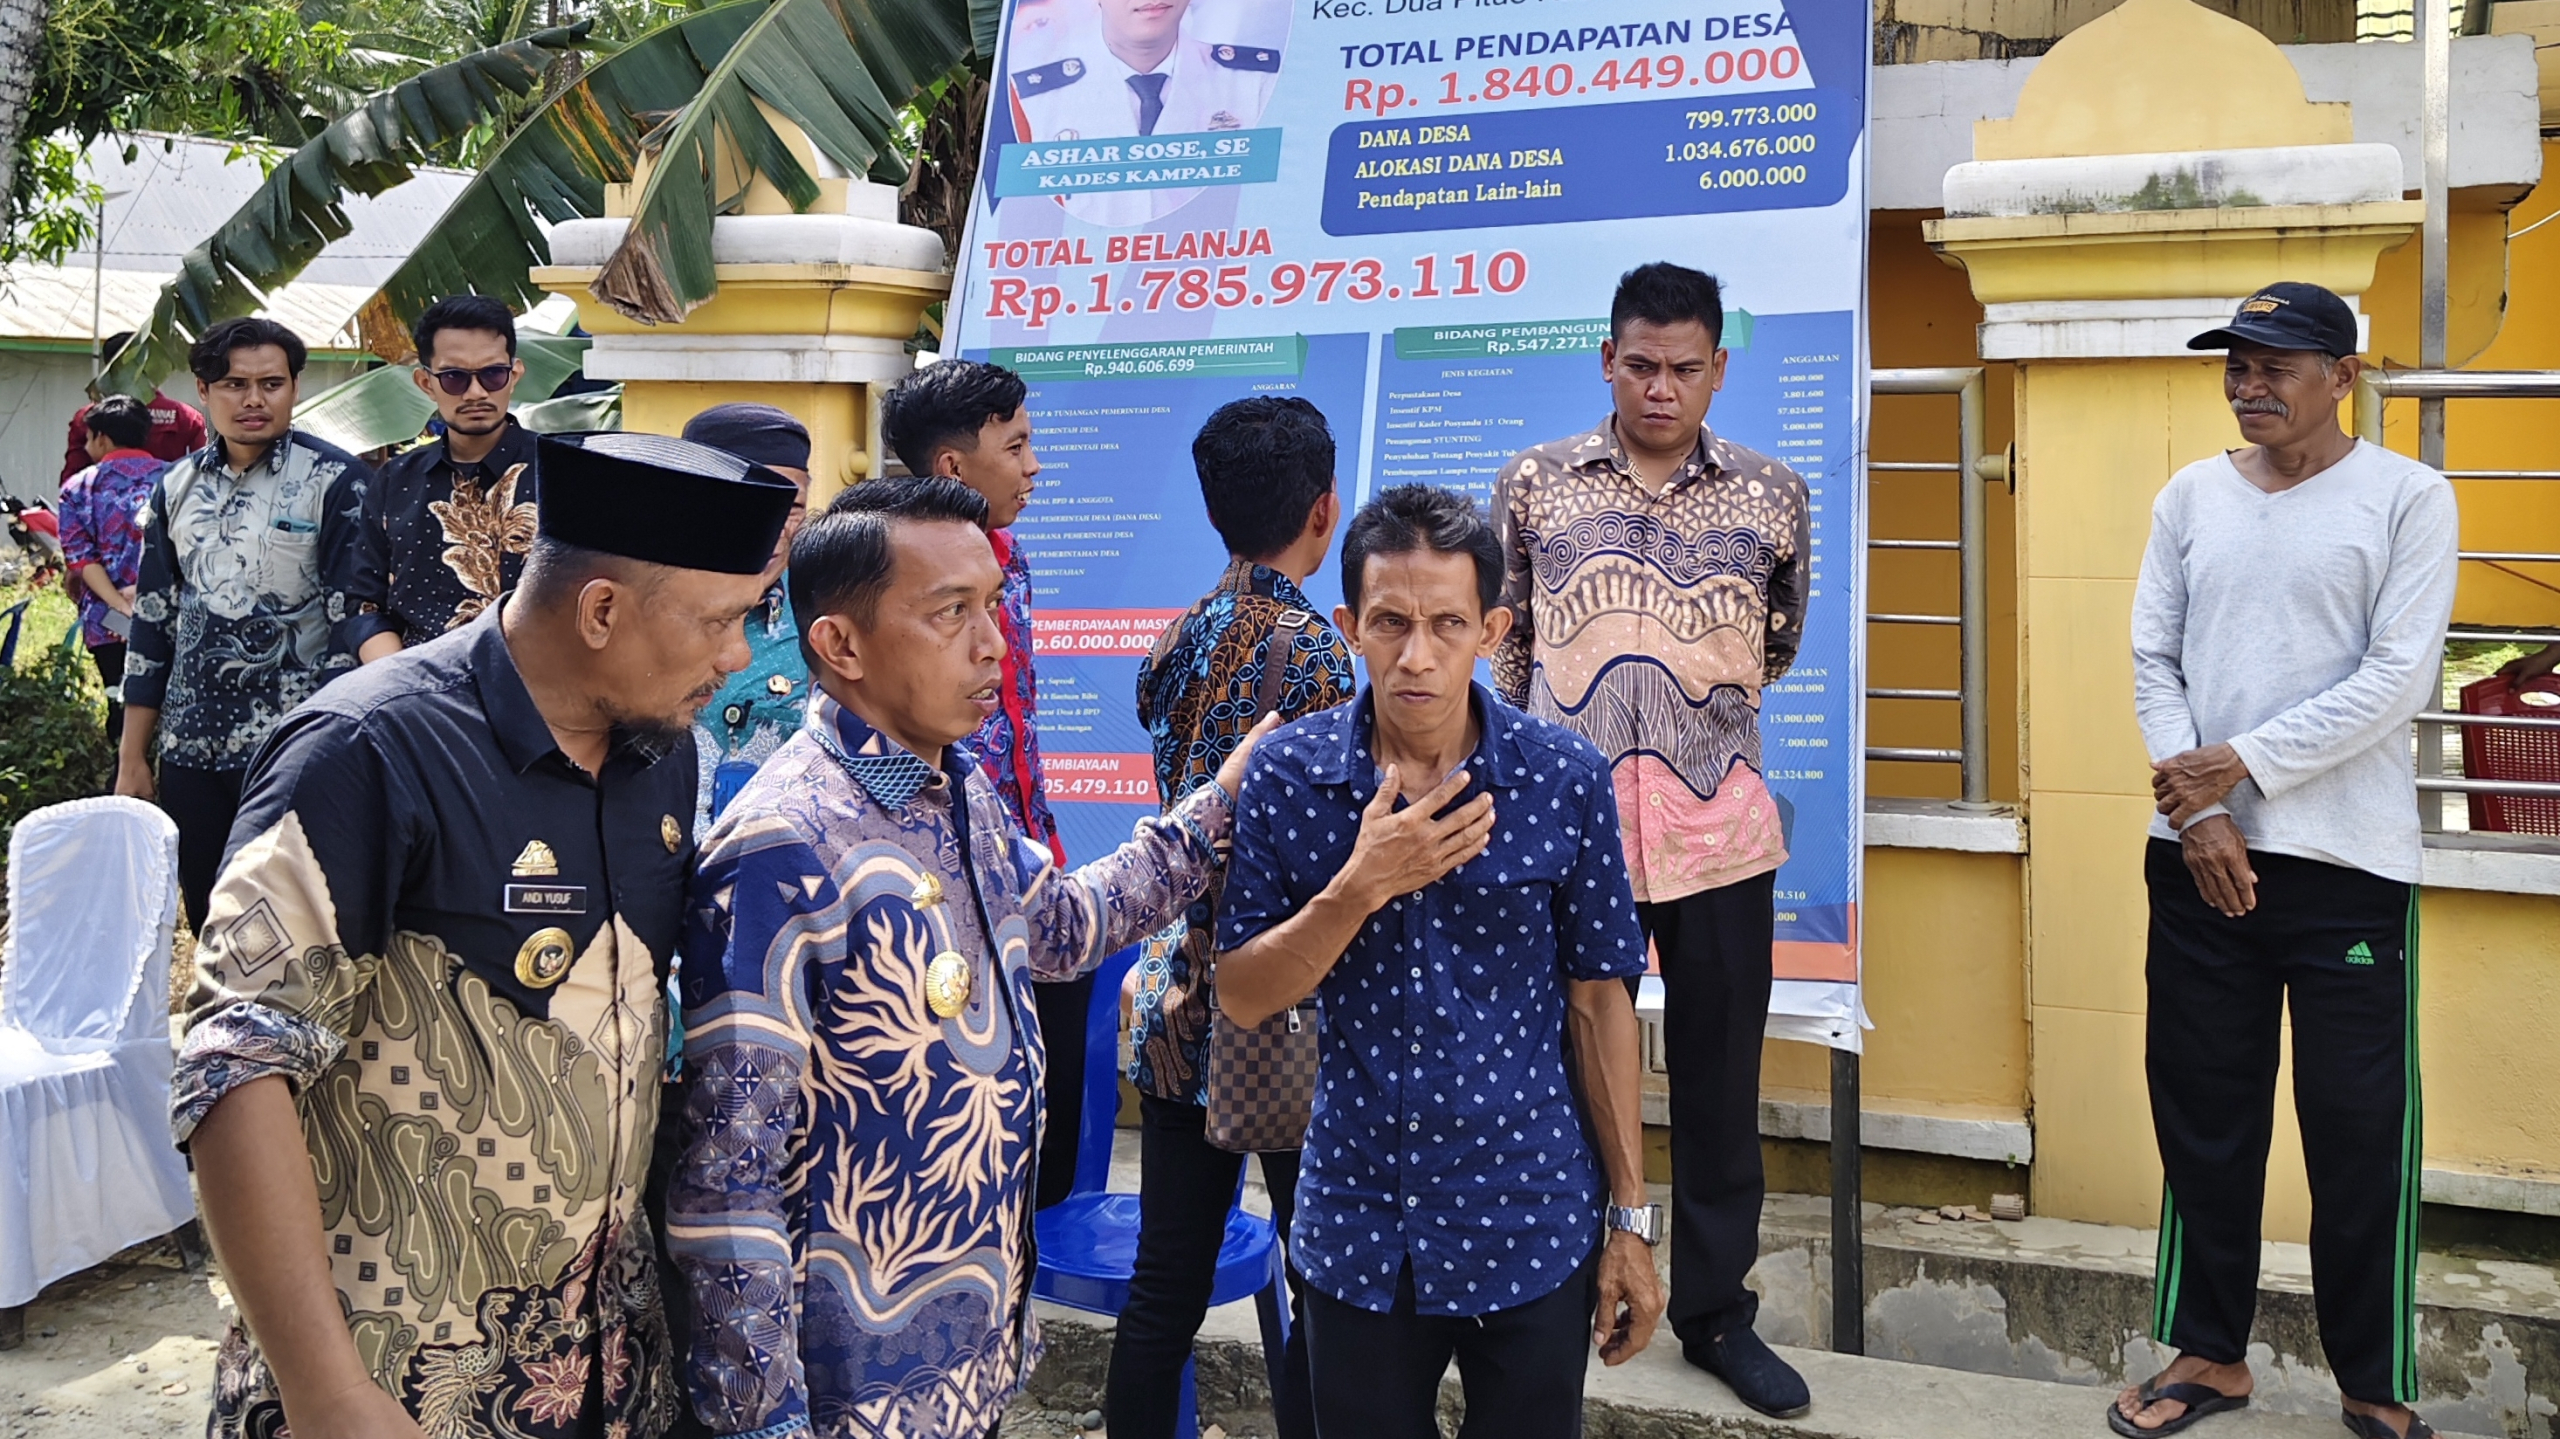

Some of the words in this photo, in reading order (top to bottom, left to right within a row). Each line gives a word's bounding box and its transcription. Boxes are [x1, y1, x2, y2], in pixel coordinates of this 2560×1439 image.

[1312, 0, 1373, 20] Kec.
[1339, 39, 1444, 69] TOTAL
[1454, 19, 1692, 61] PENDAPATAN
[1704, 11, 1797, 41] DESA
[1343, 77, 1419, 117] Rp.
[1437, 44, 1802, 105] 1.840.449.000
[1685, 103, 1817, 131] 799.773.000
[1357, 128, 1412, 150] DANA
[1417, 124, 1471, 144] DESA
[1021, 144, 1120, 168] ASHAR
[1127, 139, 1207, 161] SOSE,
[1214, 136, 1251, 157] SE
[1664, 134, 1816, 164] 1.034.676.000
[1354, 156, 1442, 179] ALOKASI
[1447, 152, 1503, 174] DANA
[1509, 147, 1564, 169] DESA
[1038, 170, 1120, 189] KADES
[1126, 163, 1243, 185] KAMPALE
[1698, 165, 1808, 190] 6.000.000
[1357, 187, 1469, 211] Pendapatan
[1475, 179, 1563, 203] Lain-lain
[983, 239, 1094, 269] TOTAL
[1105, 228, 1273, 264] BELANJA
[983, 250, 1528, 329] Rp.1.785.973.110
[1433, 327, 1497, 341] BIDANG
[1501, 322, 1612, 339] PEMBANGUN
[1486, 336, 1610, 355] Rp.547.271.1
[1014, 350, 1065, 364] BIDANG
[1067, 345, 1193, 362] PENYELENGGARAN
[1195, 341, 1275, 357] PEMERINTAH
[1782, 353, 1840, 364] ANGGARAN
[1084, 358, 1196, 378] Rp.940.606.699
[1440, 370, 1465, 379] JENIS
[1467, 367, 1514, 377] KEGIATAN
[1778, 373, 1825, 384] 10.000.000
[1251, 382, 1297, 392] ANGGARAN
[1388, 390, 1441, 401] Perpustakaan
[1442, 389, 1462, 398] Desa
[1026, 410, 1046, 418] ETAP
[1054, 408, 1100, 418] TUNJANGAN
[1100, 407, 1150, 416] PEMERINTAH
[1151, 406, 1171, 414] DESA
[1421, 405, 1443, 414] KPM
[1443, 418, 1482, 430] Posyandu
[1484, 418, 1494, 426] 15
[1497, 417, 1525, 427] Orang
[1079, 426, 1099, 434] DESA
[1433, 435, 1482, 444] STUNTING
[1776, 438, 1823, 448] 10.000.000
[1050, 443, 1099, 452] PEMERINTAH
[1100, 442, 1120, 451] DESA
[1431, 451, 1463, 462] Tentang
[1465, 449, 1500, 460] Penyakit
[1501, 448, 1518, 458] Tub
[1039, 462, 1069, 470] NGGOTA
[1439, 466, 1468, 477] Lampu
[1076, 496, 1114, 505] ANGGOTA
[1040, 514, 1090, 523] PEMERINTAH
[1091, 513, 1111, 522] DESA
[1063, 531, 1113, 540] PEMERINTAH
[1114, 530, 1134, 539] DESA
[1038, 550, 1099, 559] PEMERINTAHAN
[1100, 549, 1120, 558] DESA
[1030, 568, 1086, 577] EMERINTAHAN
[1032, 587, 1060, 595] NAHAN
[1030, 619, 1131, 632] PEMBERDAYAAN
[1133, 618, 1172, 631] MASY
[1032, 634, 1155, 653] p.60.000.000
[1784, 667, 1828, 677] GGARAN
[1769, 683, 1825, 694] 10.000.000
[1769, 713, 1826, 724] 15.000.000
[1778, 737, 1829, 748] 7.000.000
[1767, 769, 1824, 780] 82.324.800
[1043, 778, 1150, 796] 05.479.110
[522, 892, 544, 903] ANDI
[545, 892, 572, 904] YUSUF
[1772, 889, 1807, 901] 70.510
